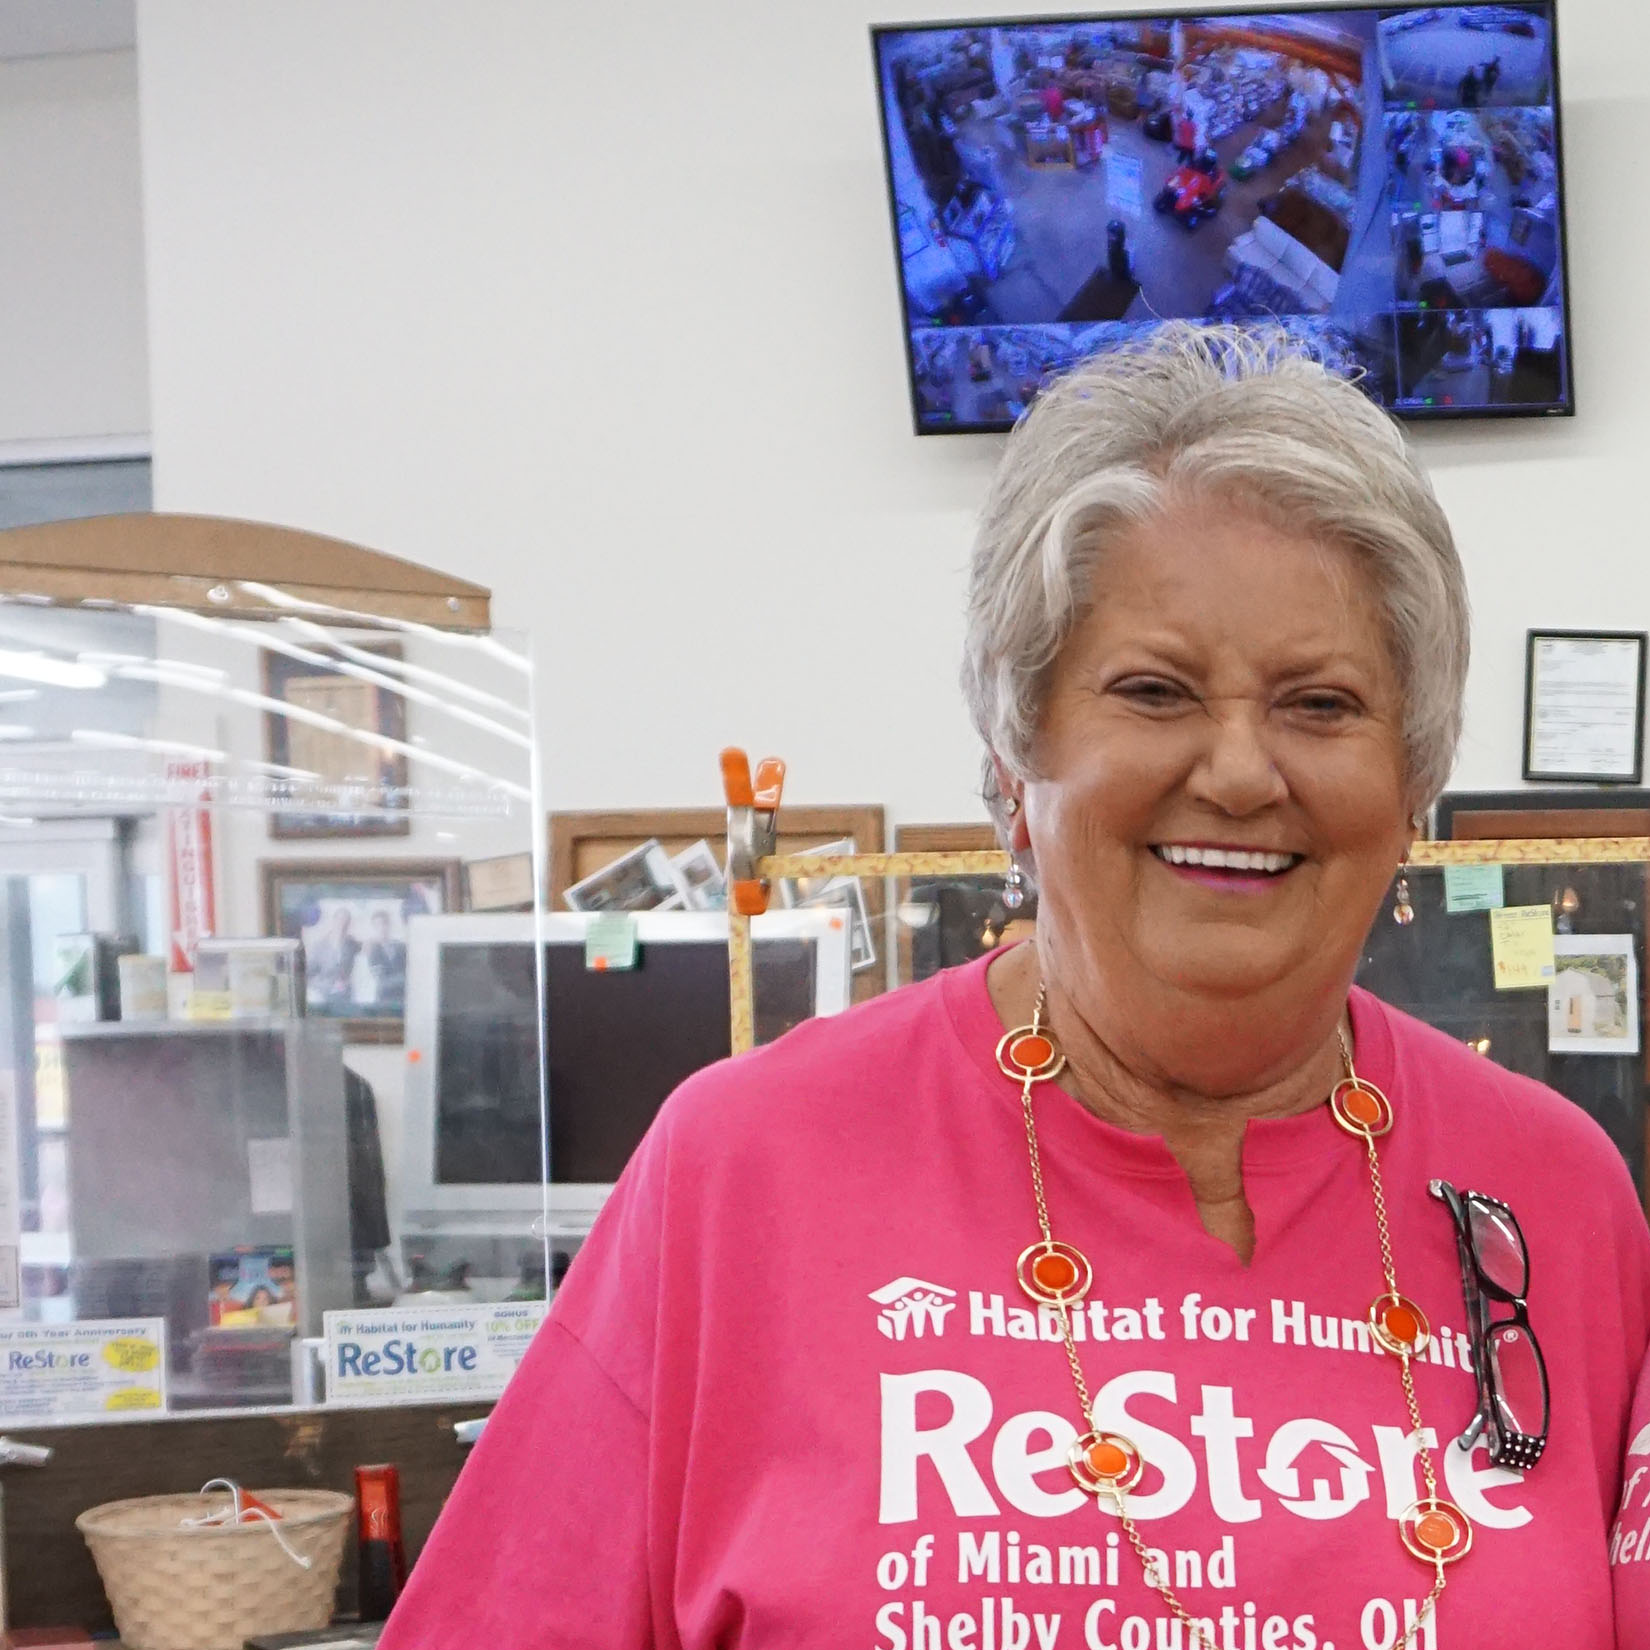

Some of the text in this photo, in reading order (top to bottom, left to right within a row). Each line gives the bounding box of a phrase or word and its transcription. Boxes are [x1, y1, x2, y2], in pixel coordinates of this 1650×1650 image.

[356, 1319, 476, 1334] Habitat for Humanity
[1180, 1293, 1256, 1341] for
[8, 1349, 91, 1371] ReStore
[338, 1340, 478, 1378] ReStore
[878, 1369, 1534, 1530] ReStore
[876, 1531, 1237, 1591] of Miami and
